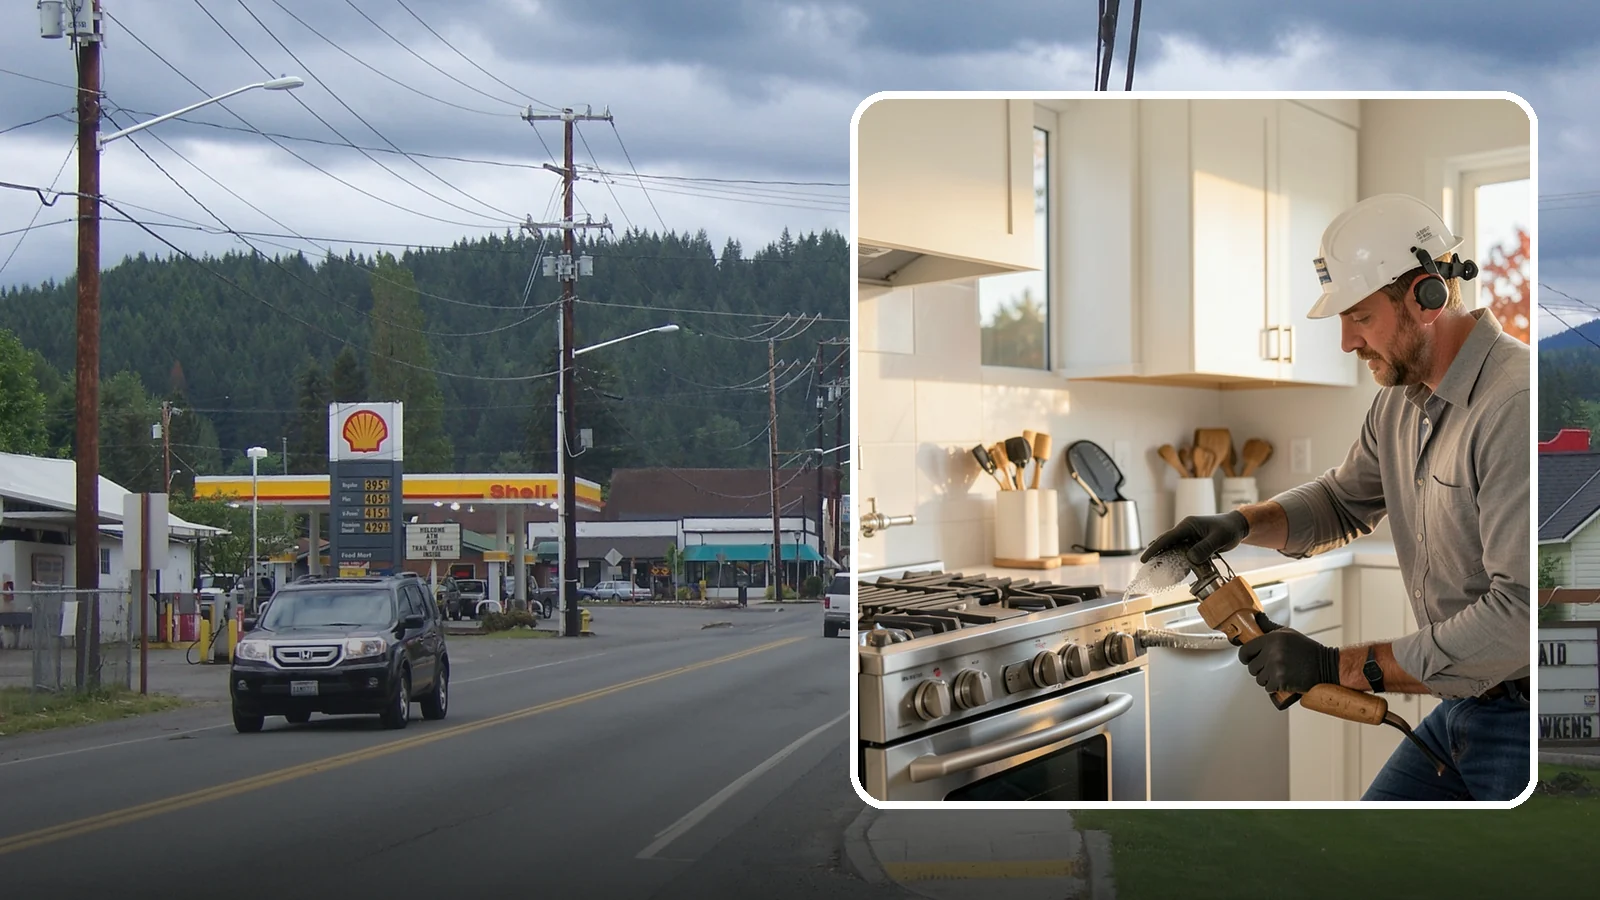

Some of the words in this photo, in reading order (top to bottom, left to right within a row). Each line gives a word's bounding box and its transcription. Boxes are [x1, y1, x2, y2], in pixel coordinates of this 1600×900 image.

[365, 480, 384, 490] 395
[490, 484, 547, 499] Shell
[365, 494, 384, 504] 405
[365, 508, 384, 518] 415
[365, 522, 384, 532] 429
